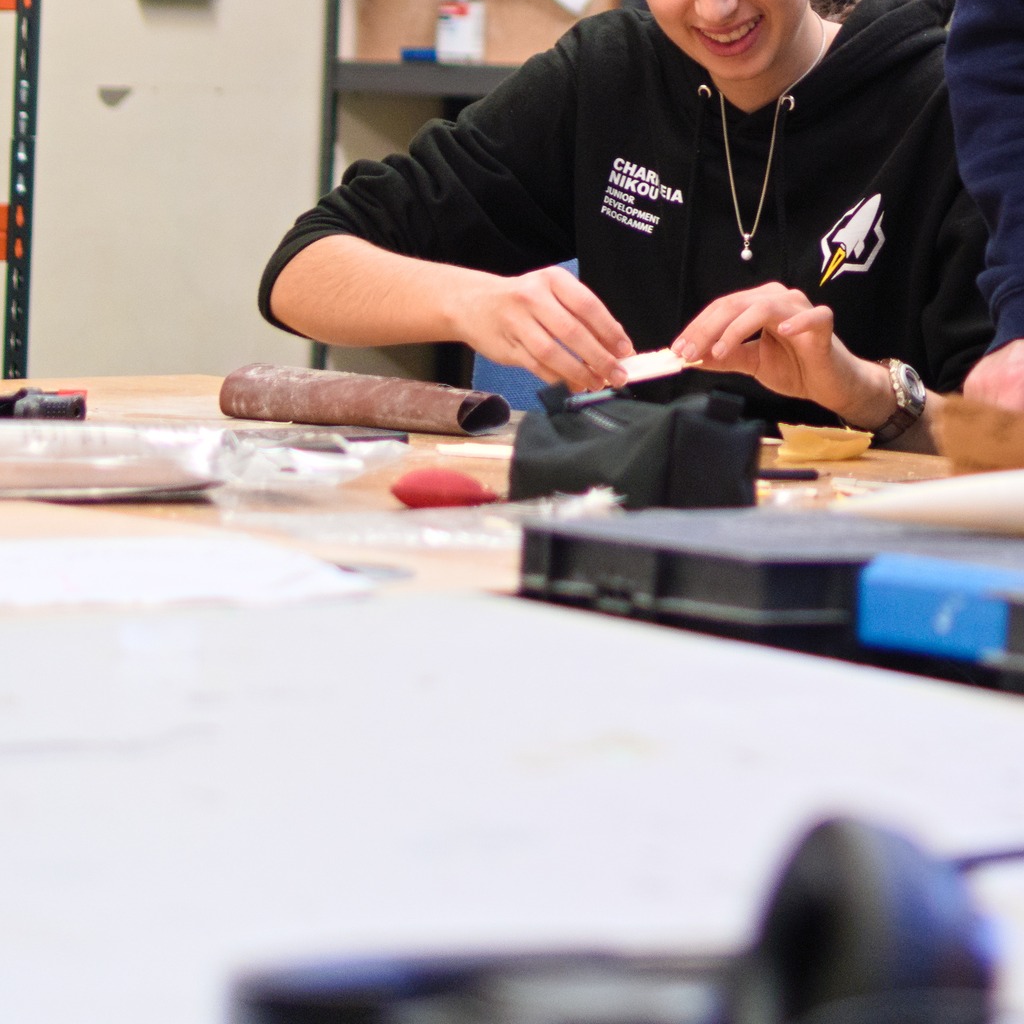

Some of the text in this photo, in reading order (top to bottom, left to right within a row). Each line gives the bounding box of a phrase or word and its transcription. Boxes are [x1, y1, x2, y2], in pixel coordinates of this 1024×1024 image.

[605, 185, 636, 205] JUNIOR
[600, 205, 654, 234] PROGRAMME
[603, 195, 660, 225] DEVELOPMENT
